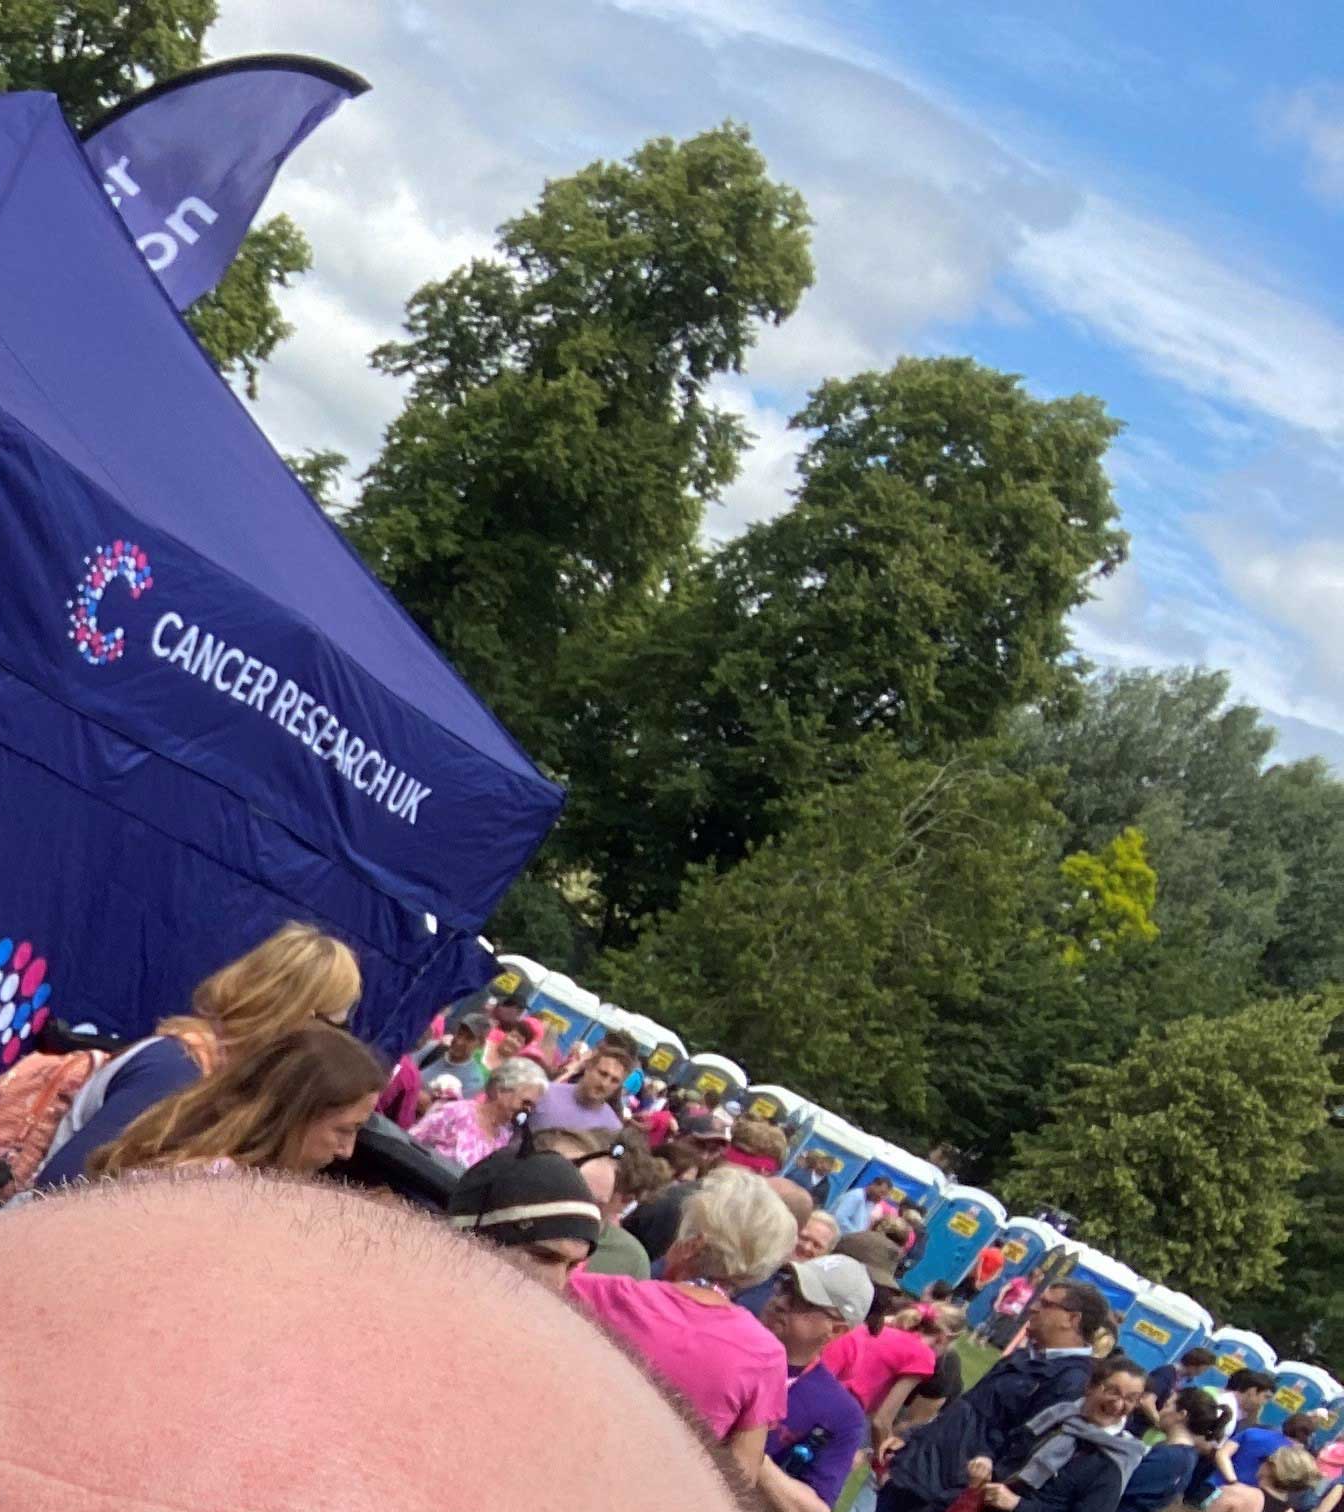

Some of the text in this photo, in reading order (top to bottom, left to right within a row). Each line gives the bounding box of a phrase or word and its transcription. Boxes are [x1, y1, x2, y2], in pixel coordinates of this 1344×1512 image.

[152, 611, 432, 825] CANCER RESEARCH UK
